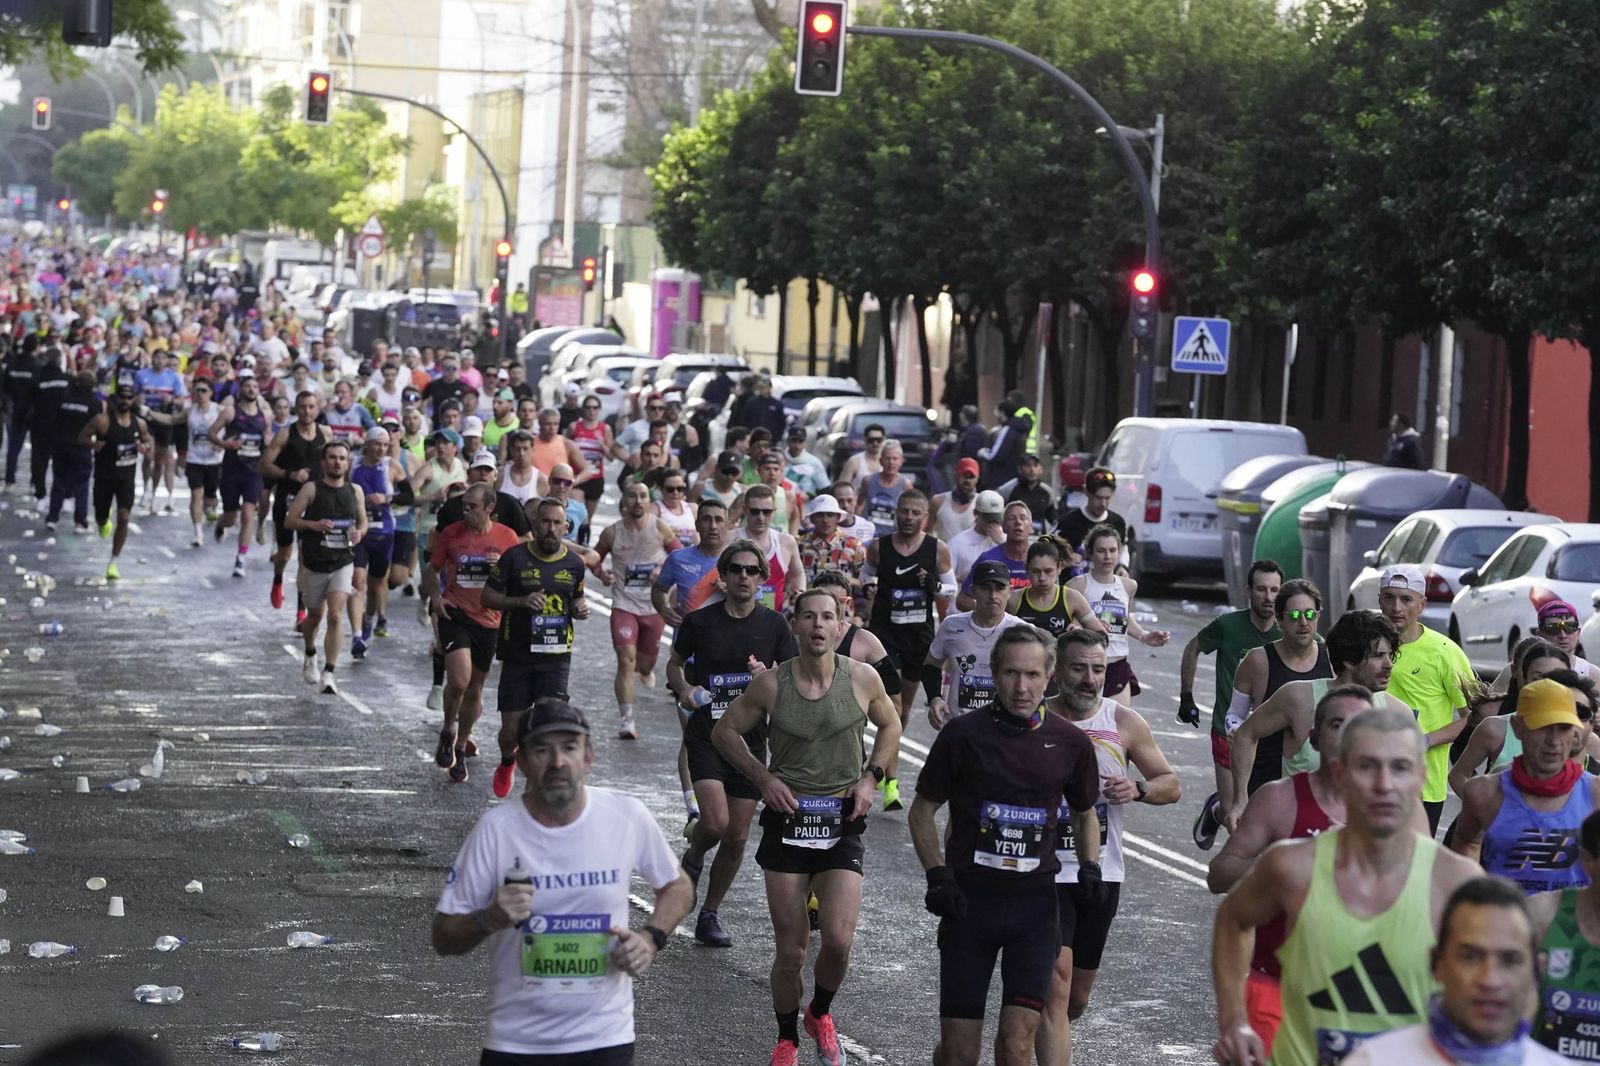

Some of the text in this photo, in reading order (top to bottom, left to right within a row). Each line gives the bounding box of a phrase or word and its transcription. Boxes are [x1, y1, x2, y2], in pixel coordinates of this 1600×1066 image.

[726, 675, 753, 683] ZURICH
[802, 800, 835, 808] ZURICH
[803, 816, 822, 824] 5118
[1003, 809, 1040, 821] ZURICH
[794, 826, 830, 838] PAULO
[1001, 828, 1024, 840] 4698
[995, 839, 1027, 857] YEYU
[1061, 836, 1075, 849] TE
[532, 870, 620, 889] VINCIBLE
[552, 918, 601, 931] ZURICH
[553, 942, 580, 954] 3402
[533, 958, 599, 975] ARNAUD
